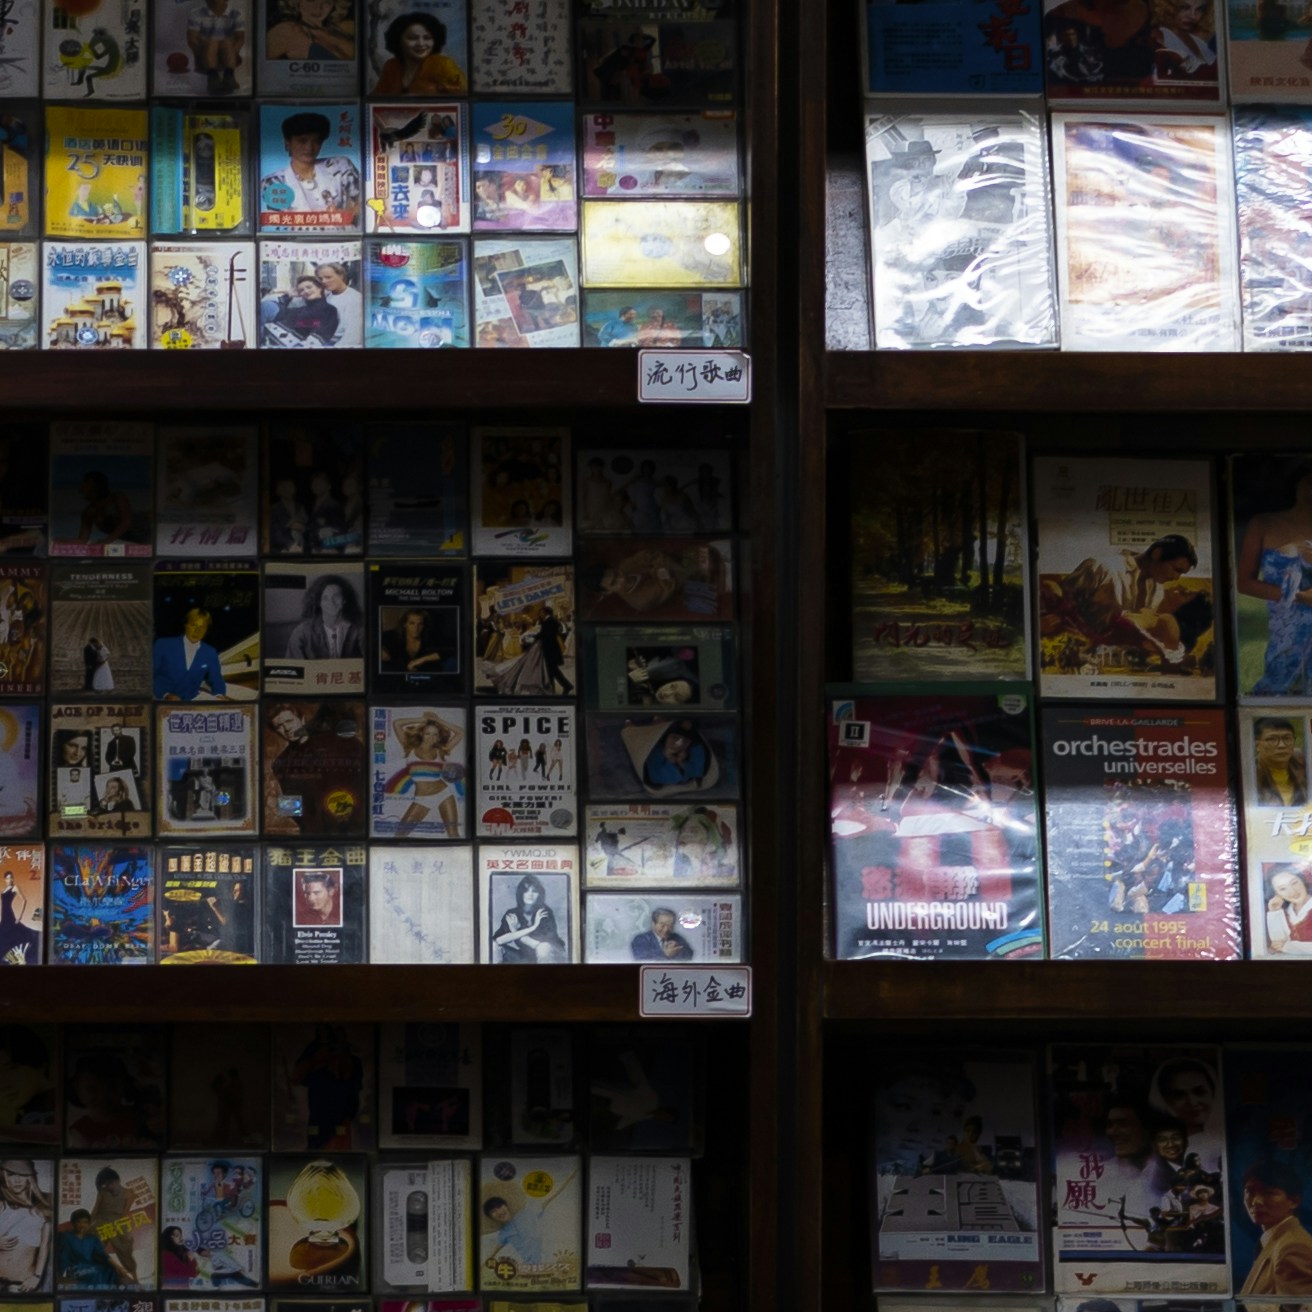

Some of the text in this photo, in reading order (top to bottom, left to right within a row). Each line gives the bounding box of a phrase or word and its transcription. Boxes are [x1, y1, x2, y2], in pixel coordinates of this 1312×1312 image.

[646, 360, 742, 391] 流行歌曲
[1095, 483, 1196, 514] 亂世佳人
[70, 571, 134, 582] TENDERNESS
[315, 671, 362, 685] 肯尼基
[481, 716, 570, 735] SPICE
[1052, 734, 1219, 758] orchestrades
[1103, 757, 1218, 777] universelles
[483, 784, 513, 792] GIRL
[268, 848, 367, 867] 猫王金曲
[866, 901, 1009, 932] UNDERGROUND
[1089, 919, 1187, 933] 24 août 1995
[1114, 935, 1209, 950] concert final
[651, 973, 747, 1008] 海外金曲
[98, 1212, 153, 1242] 流行风
[948, 1234, 1033, 1245] KING EAGLE
[297, 1272, 359, 1286] GUERLAIN
